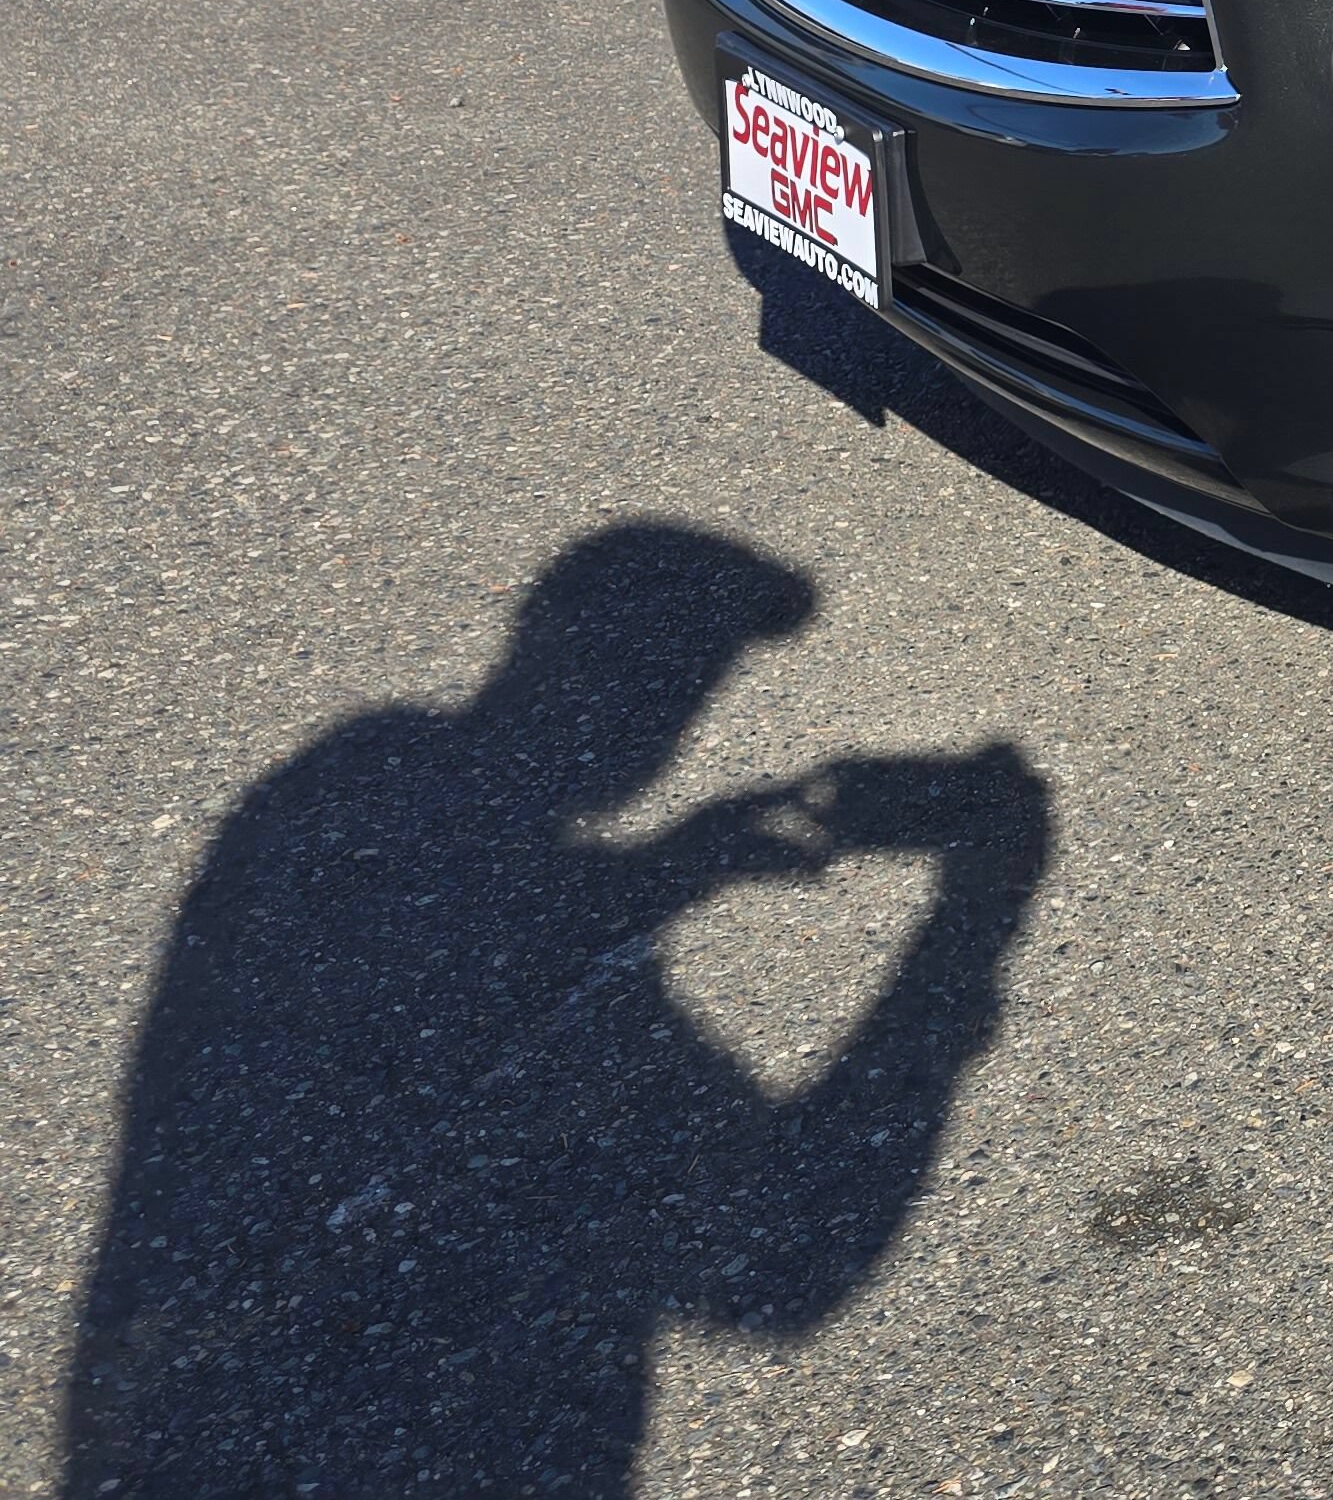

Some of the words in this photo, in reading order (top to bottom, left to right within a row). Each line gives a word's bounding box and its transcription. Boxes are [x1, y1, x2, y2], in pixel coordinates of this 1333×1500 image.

[747, 66, 838, 134] LYNNWOOD
[733, 83, 874, 218] Seaview
[722, 192, 879, 310] SEAVIEWAUTO.COM
[771, 168, 839, 247] GMC
